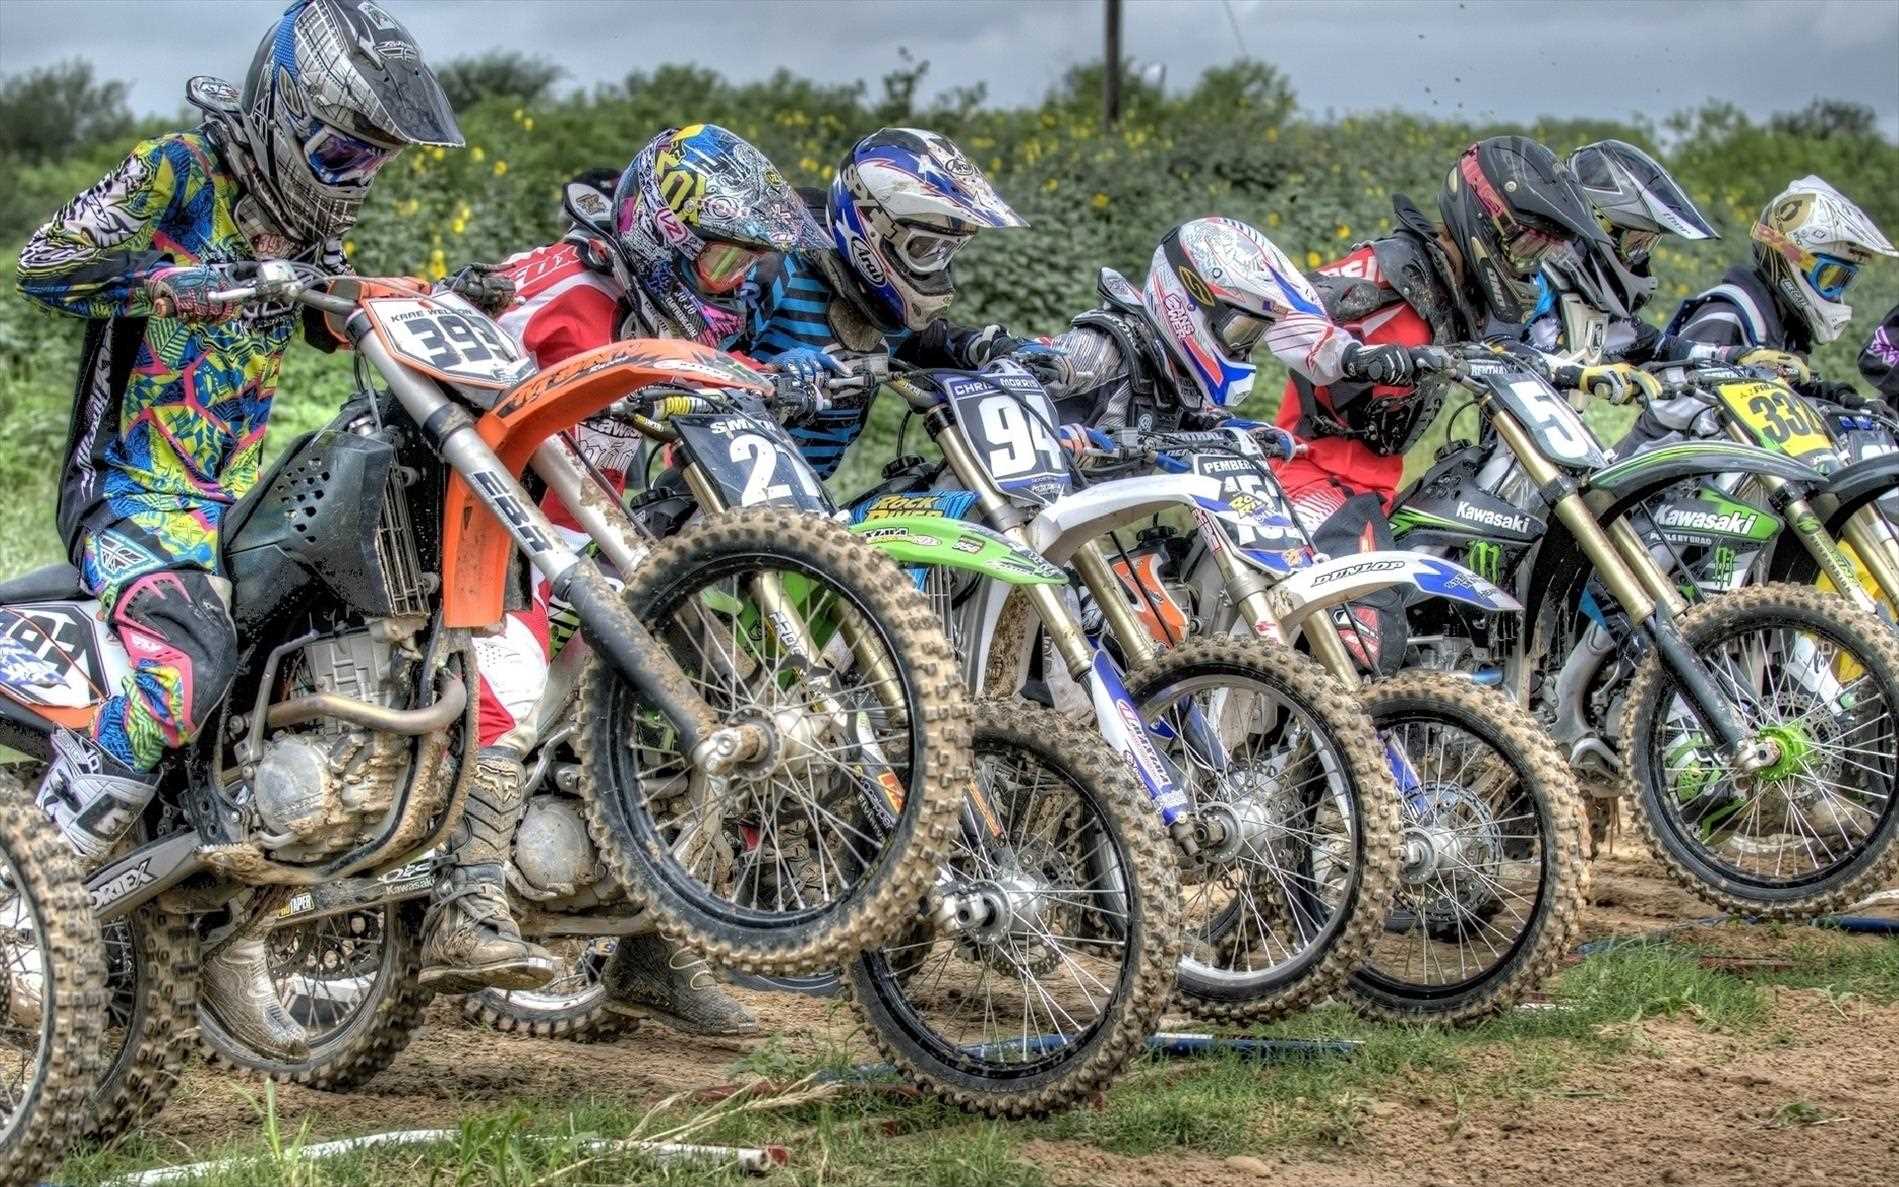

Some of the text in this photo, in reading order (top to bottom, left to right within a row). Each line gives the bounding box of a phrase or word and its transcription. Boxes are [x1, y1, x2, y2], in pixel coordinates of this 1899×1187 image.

[856, 244, 881, 280] Arai
[1000, 377, 1039, 389] MORRIS
[1510, 381, 1589, 458] 5
[1748, 391, 1825, 443] 33
[978, 394, 1063, 478] 94
[1456, 501, 1530, 534] Kawasaki
[1653, 504, 1759, 535] Kawasaki
[1311, 560, 1405, 588] DUNLOP
[90, 856, 157, 911] ORTEX
[386, 877, 435, 895] Kawasaki
